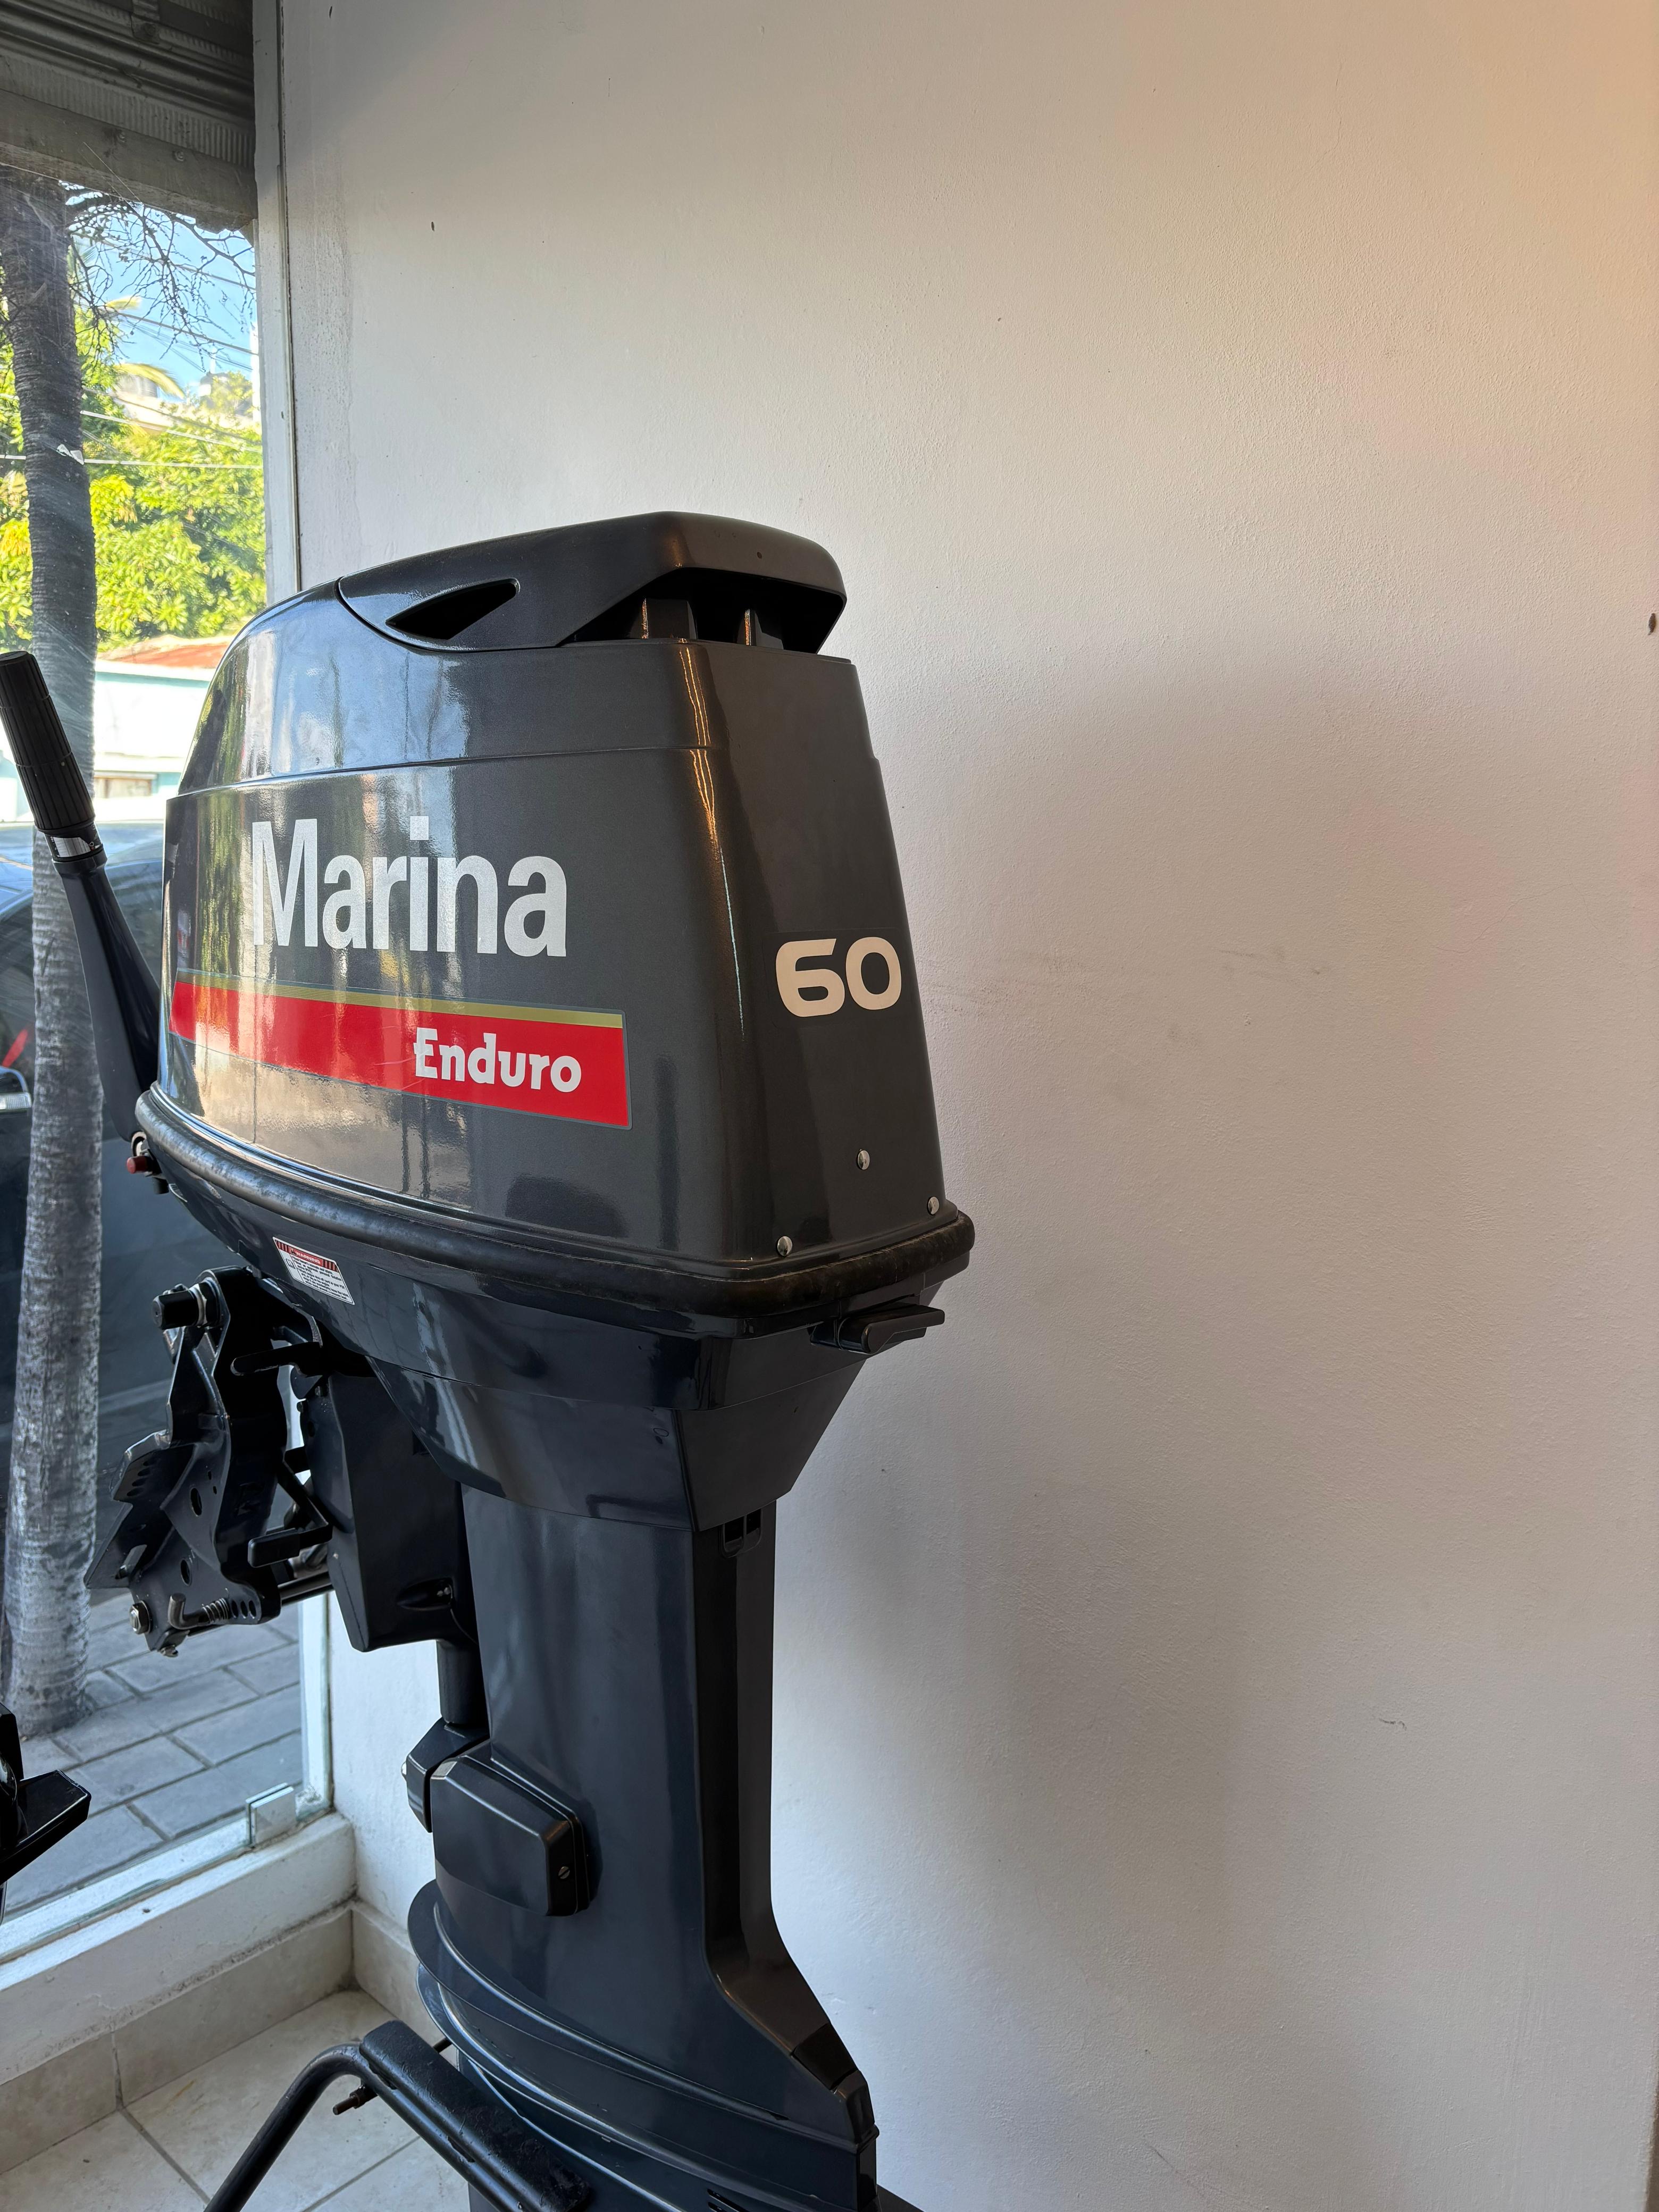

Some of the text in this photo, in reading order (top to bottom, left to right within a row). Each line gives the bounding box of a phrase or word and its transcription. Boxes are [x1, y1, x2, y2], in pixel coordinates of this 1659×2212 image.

[252, 815, 567, 957] Marina
[775, 936, 902, 1017] 60
[414, 1026, 582, 1093] Enduro
[295, 1251, 321, 1264] WARNING
